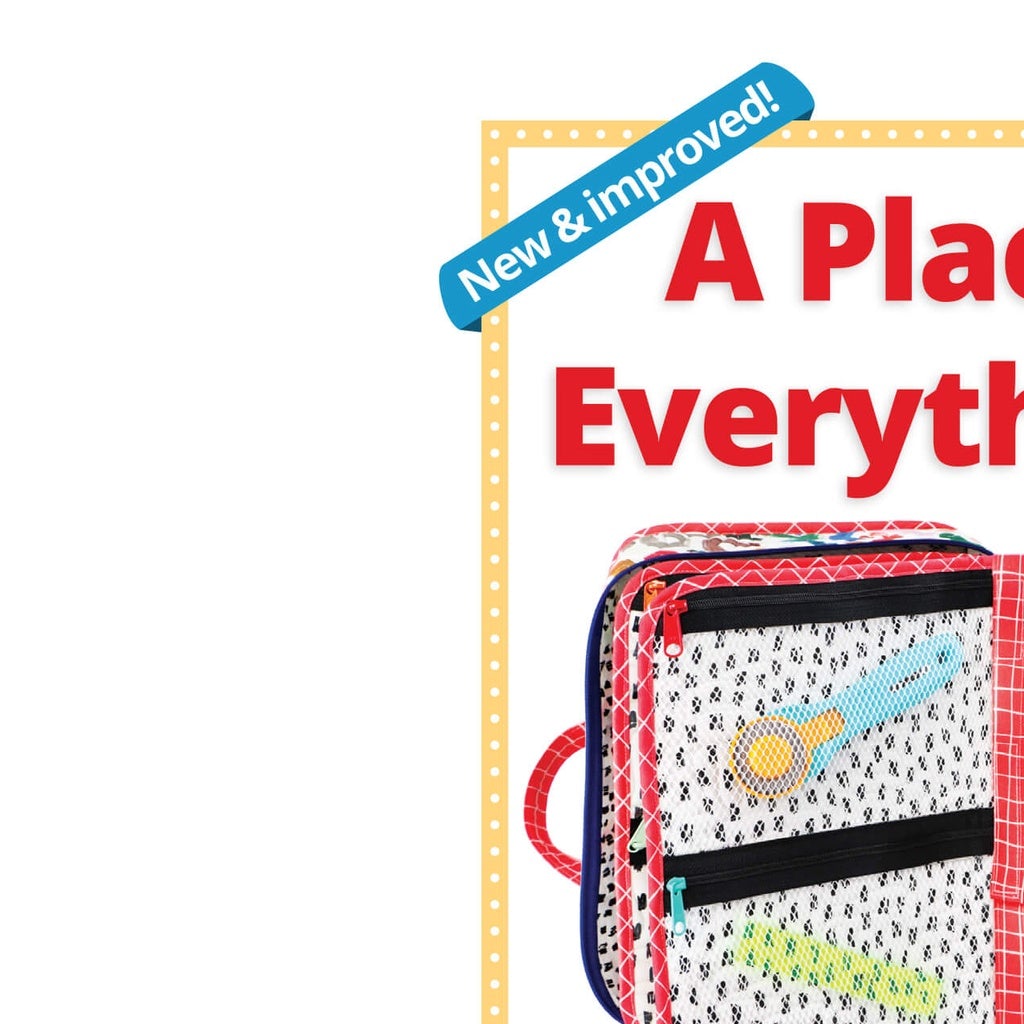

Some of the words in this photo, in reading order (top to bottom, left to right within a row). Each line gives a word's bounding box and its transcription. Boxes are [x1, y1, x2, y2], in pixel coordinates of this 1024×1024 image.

[457, 229, 551, 303] New
[550, 207, 593, 243] &
[582, 79, 781, 223] improved!
[664, 201, 765, 302] A
